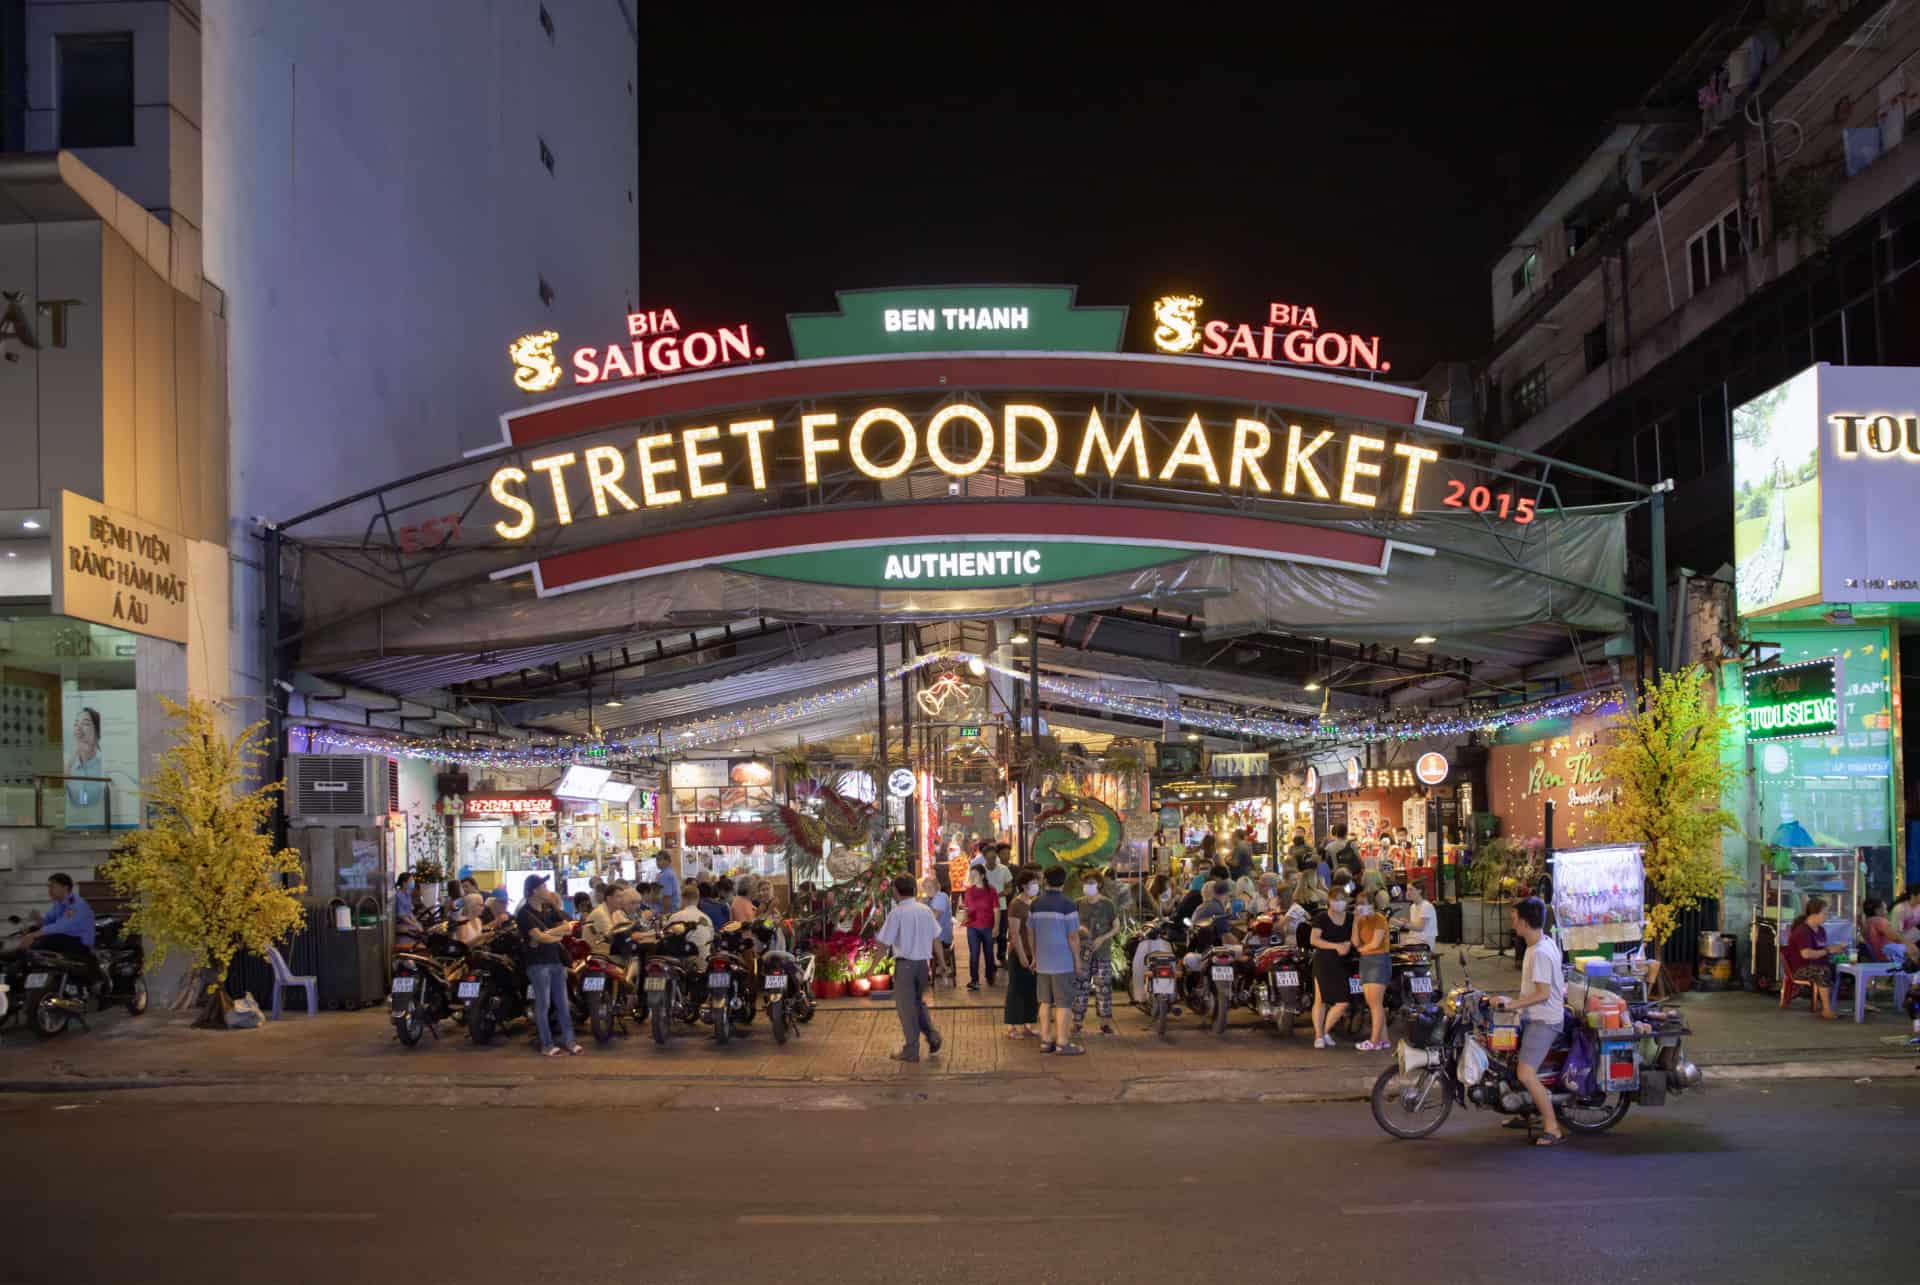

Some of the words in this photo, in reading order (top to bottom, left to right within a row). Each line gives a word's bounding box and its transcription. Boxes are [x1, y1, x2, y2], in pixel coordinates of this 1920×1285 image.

[627, 308, 681, 337] BIA
[885, 308, 935, 332] BEN
[942, 307, 1029, 331] THANH
[1269, 302, 1319, 329] BIA
[573, 324, 765, 384] SAIGON.
[489, 418, 775, 541] STREET
[801, 403, 1059, 486] FOOD
[1073, 405, 1439, 517] MARKET
[1443, 478, 1536, 526] 2015
[89, 514, 133, 553] BỆNH
[135, 531, 170, 566] VIỆN
[69, 545, 115, 581] RĂNG
[117, 560, 153, 595] HÀM
[156, 573, 187, 606] MẶT
[884, 550, 1041, 580] AUTHENTIC
